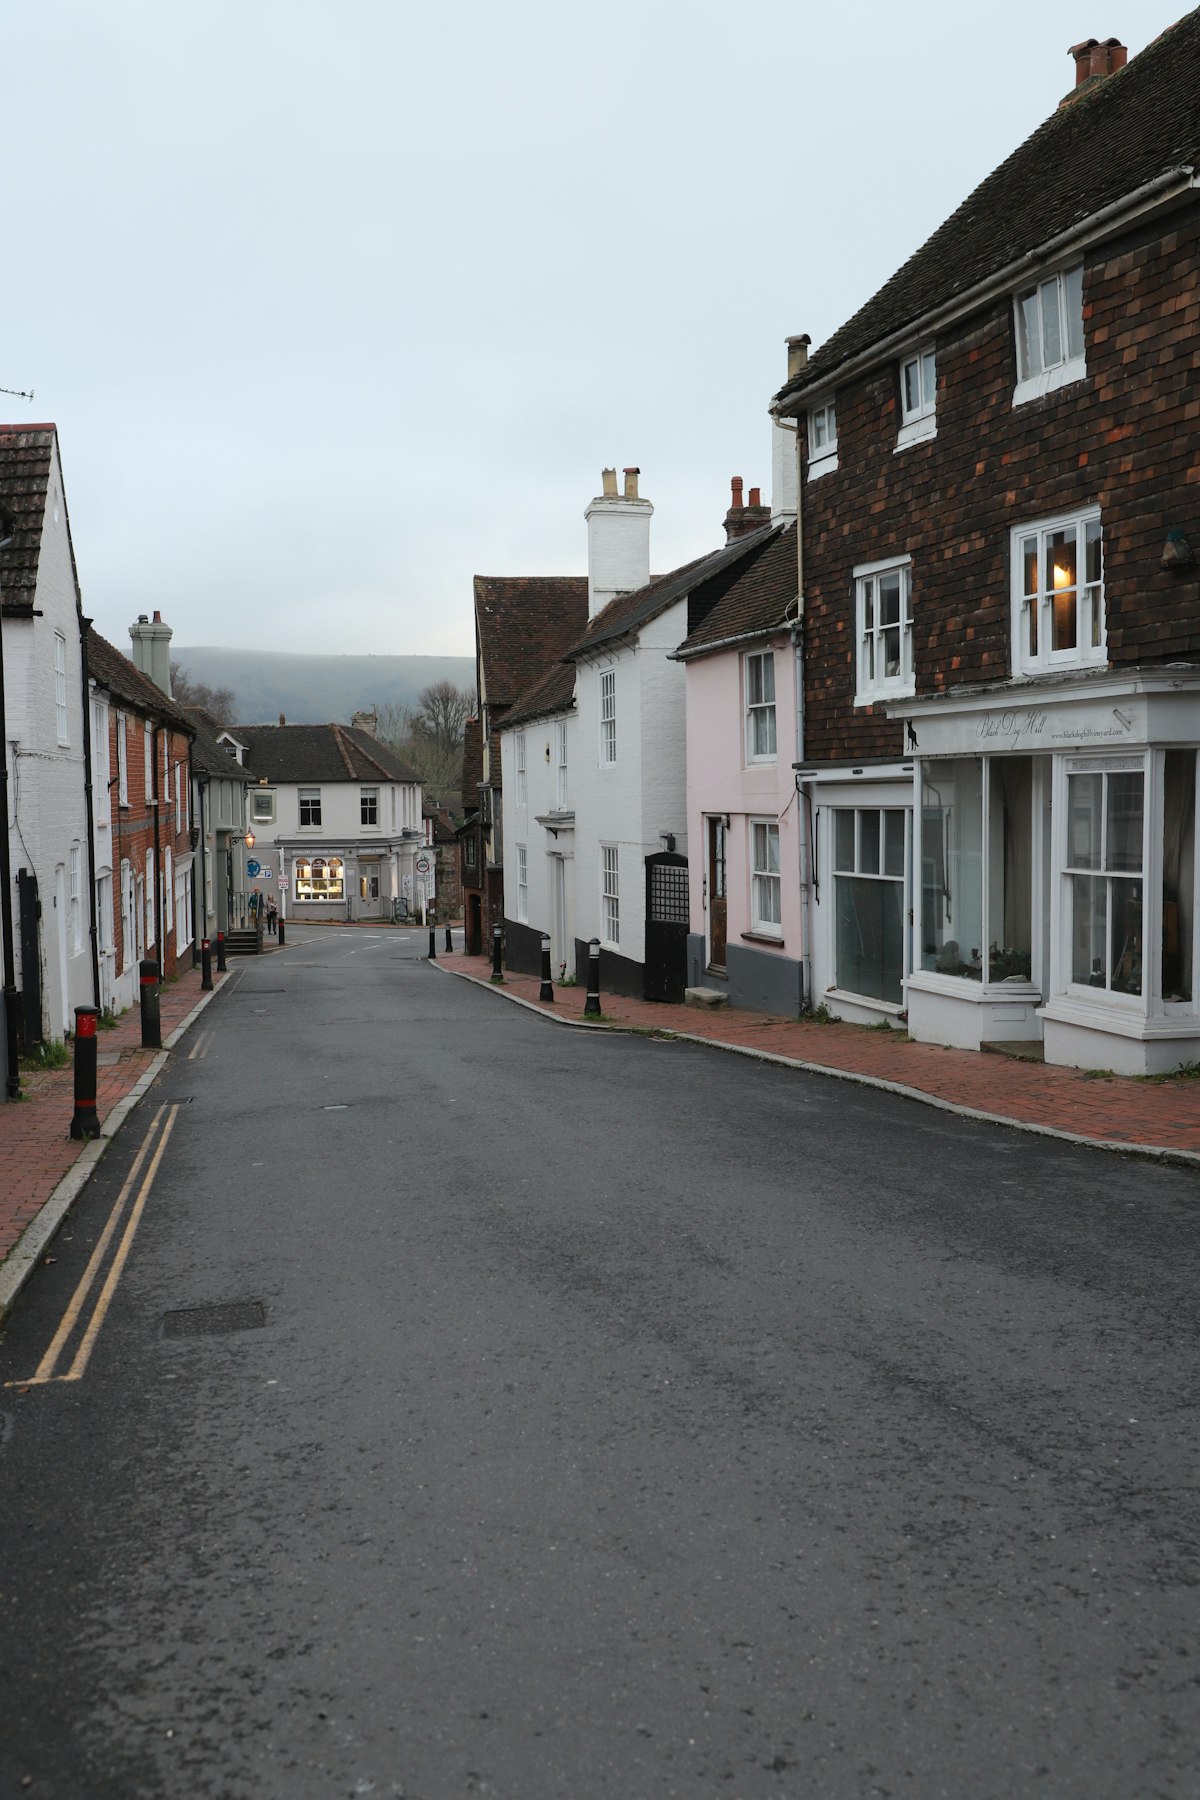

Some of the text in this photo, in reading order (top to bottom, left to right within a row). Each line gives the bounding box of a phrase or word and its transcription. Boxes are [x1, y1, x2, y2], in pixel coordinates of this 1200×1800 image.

[976, 710, 1048, 750] Black Dog Hill
